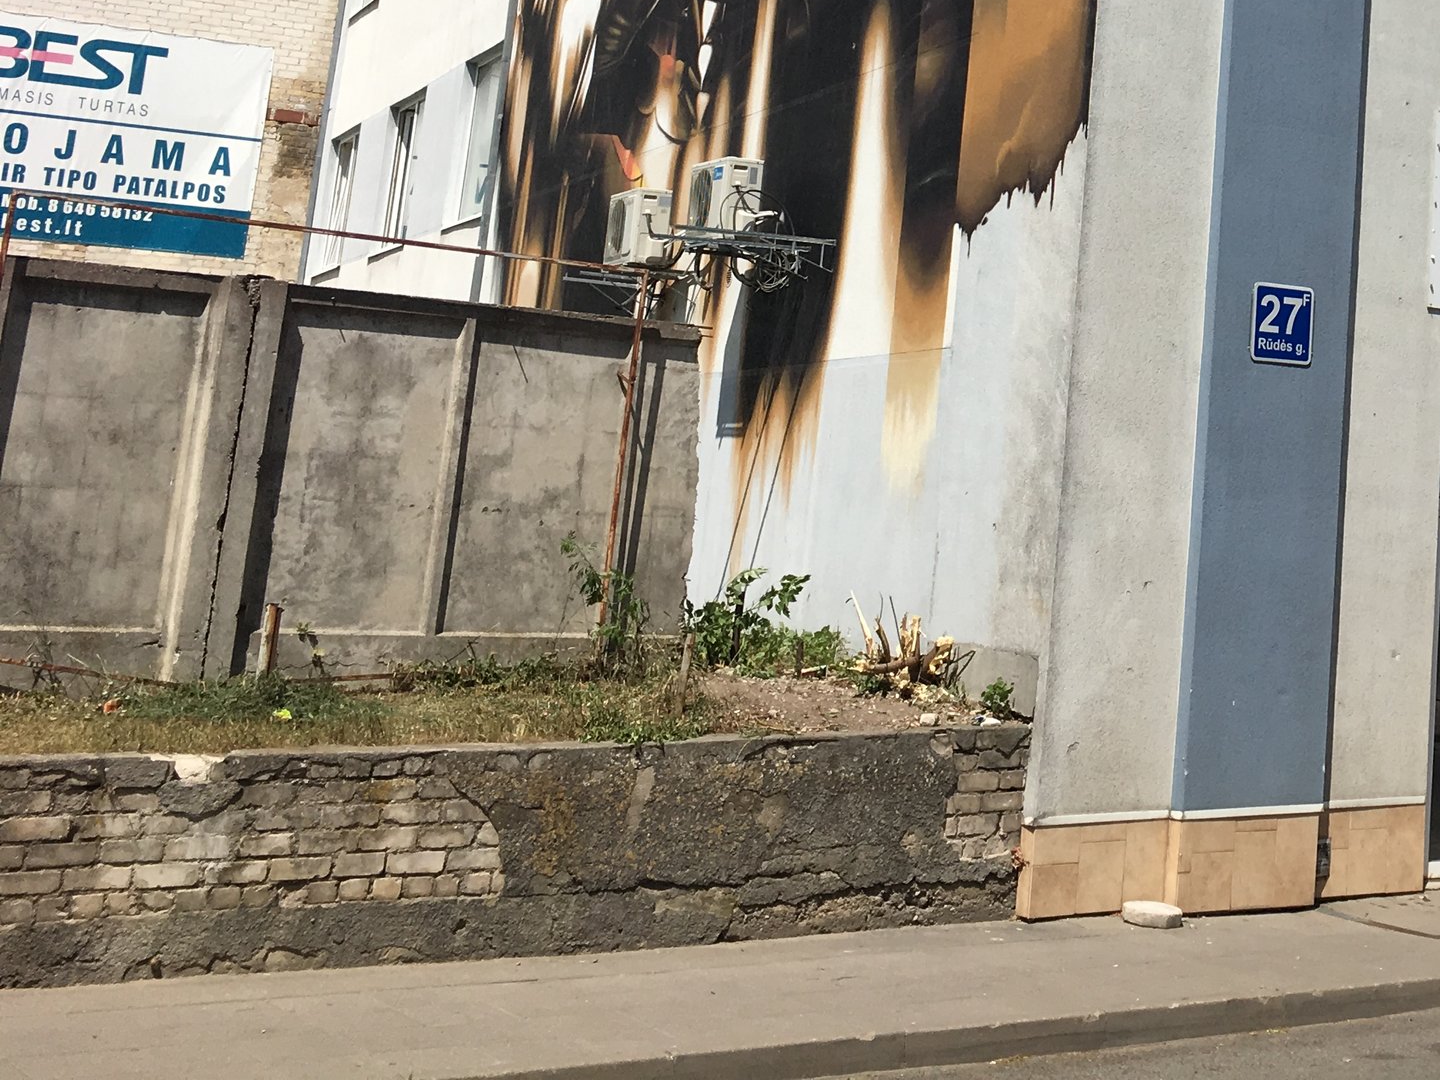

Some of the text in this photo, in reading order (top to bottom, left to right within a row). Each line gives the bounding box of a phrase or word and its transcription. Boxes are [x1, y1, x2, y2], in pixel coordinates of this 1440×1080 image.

[78, 96, 149, 117] TURTAS
[1, 162, 226, 204] IR TIPO PATALPOS
[1257, 337, 1306, 356] Rūdės g.
